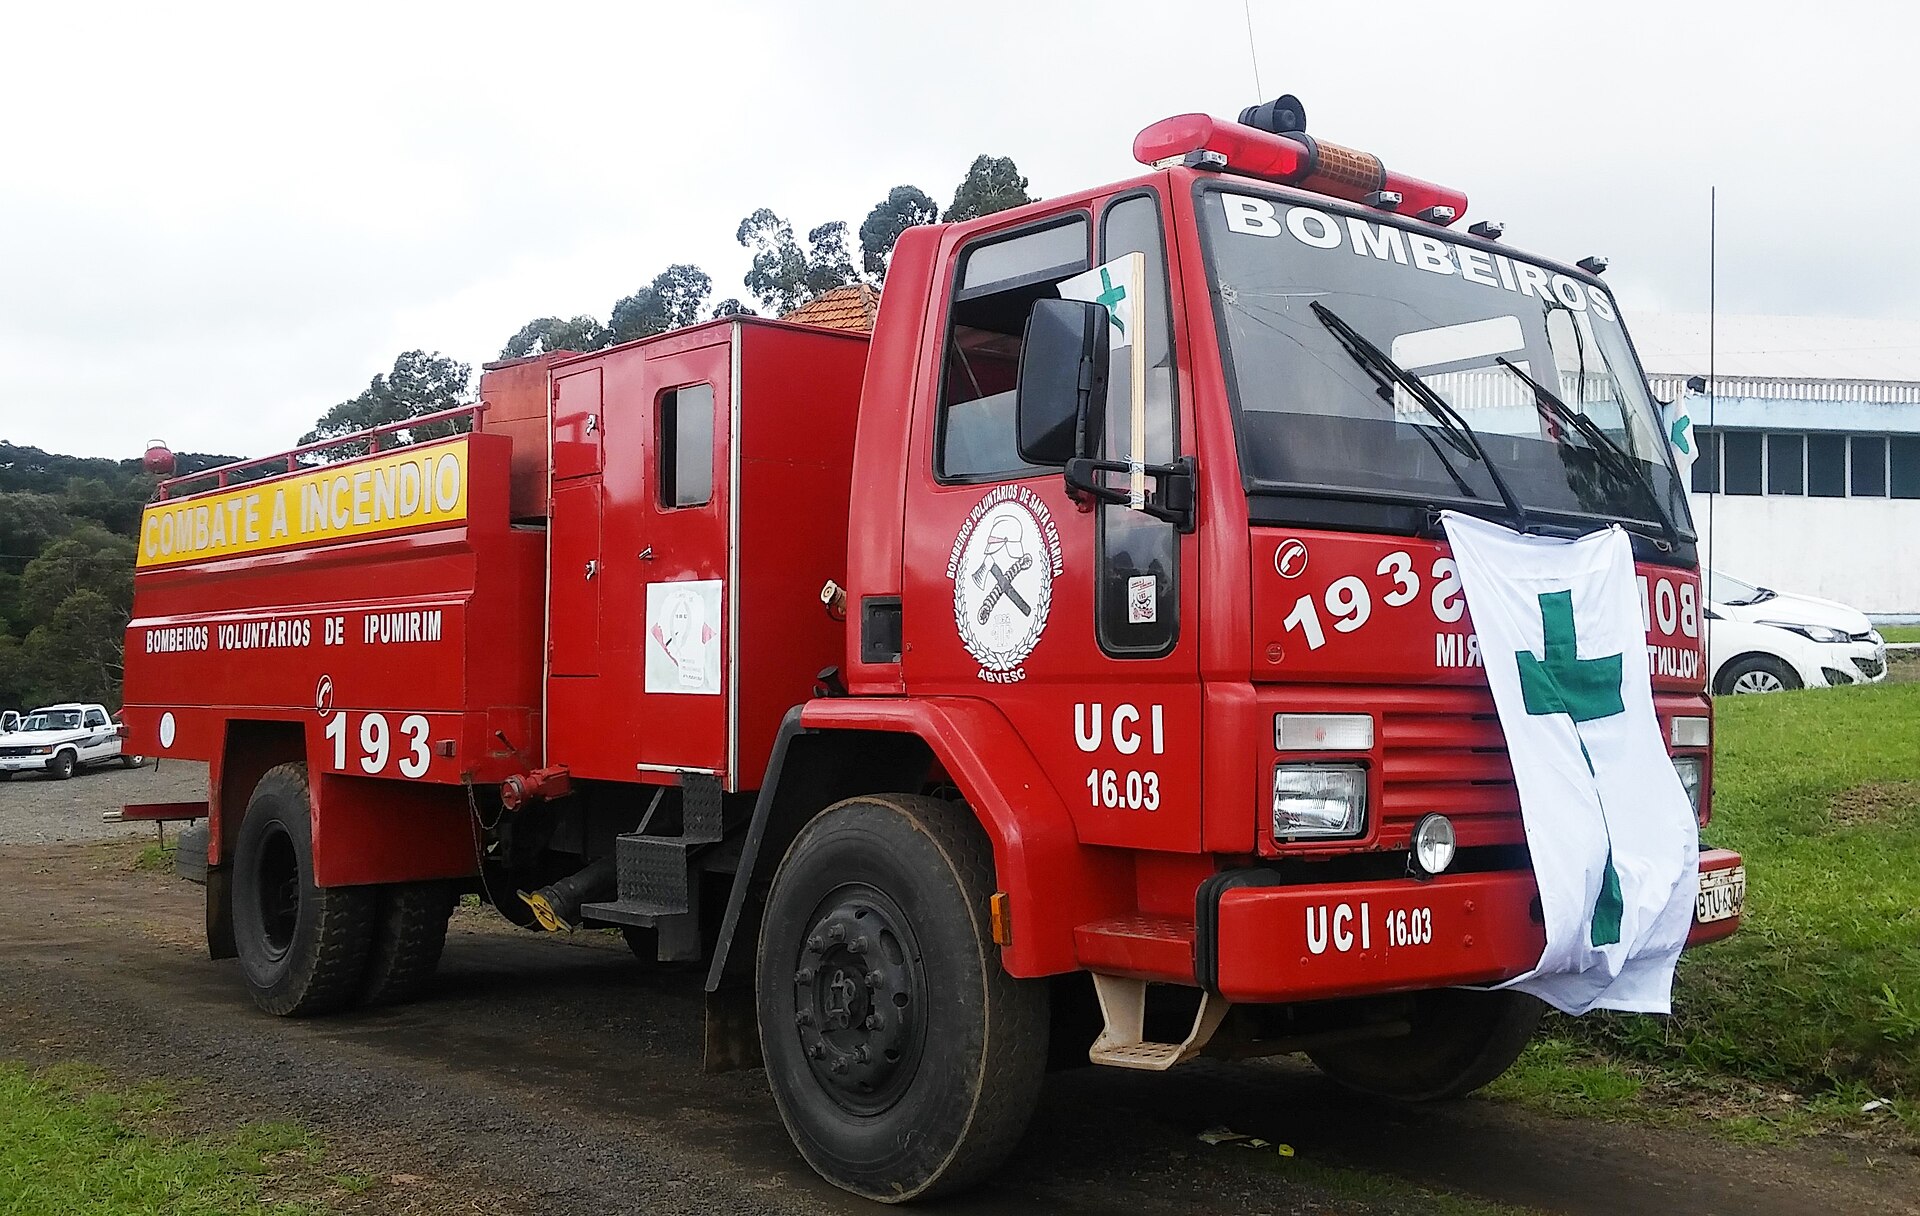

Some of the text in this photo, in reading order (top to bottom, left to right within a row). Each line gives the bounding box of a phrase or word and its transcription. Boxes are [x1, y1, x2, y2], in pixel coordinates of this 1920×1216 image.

[1220, 192, 1616, 323] BOMBEIROS
[145, 452, 461, 558] COMBATE A INCENDIO
[945, 518, 974, 579] BOMBEIROS
[1019, 485, 1030, 503] DE
[1028, 494, 1050, 526] SANTA
[1046, 521, 1064, 578] CATARINA
[146, 610, 442, 653] BOMBEIROS VOLUNTÁRIOS DE IPUMIRIM
[1283, 552, 1420, 651] 193
[325, 712, 432, 778] 193
[1074, 702, 1164, 755] UCI
[1086, 768, 1161, 811] 16.03
[1306, 902, 1432, 955] UCI 16.03
